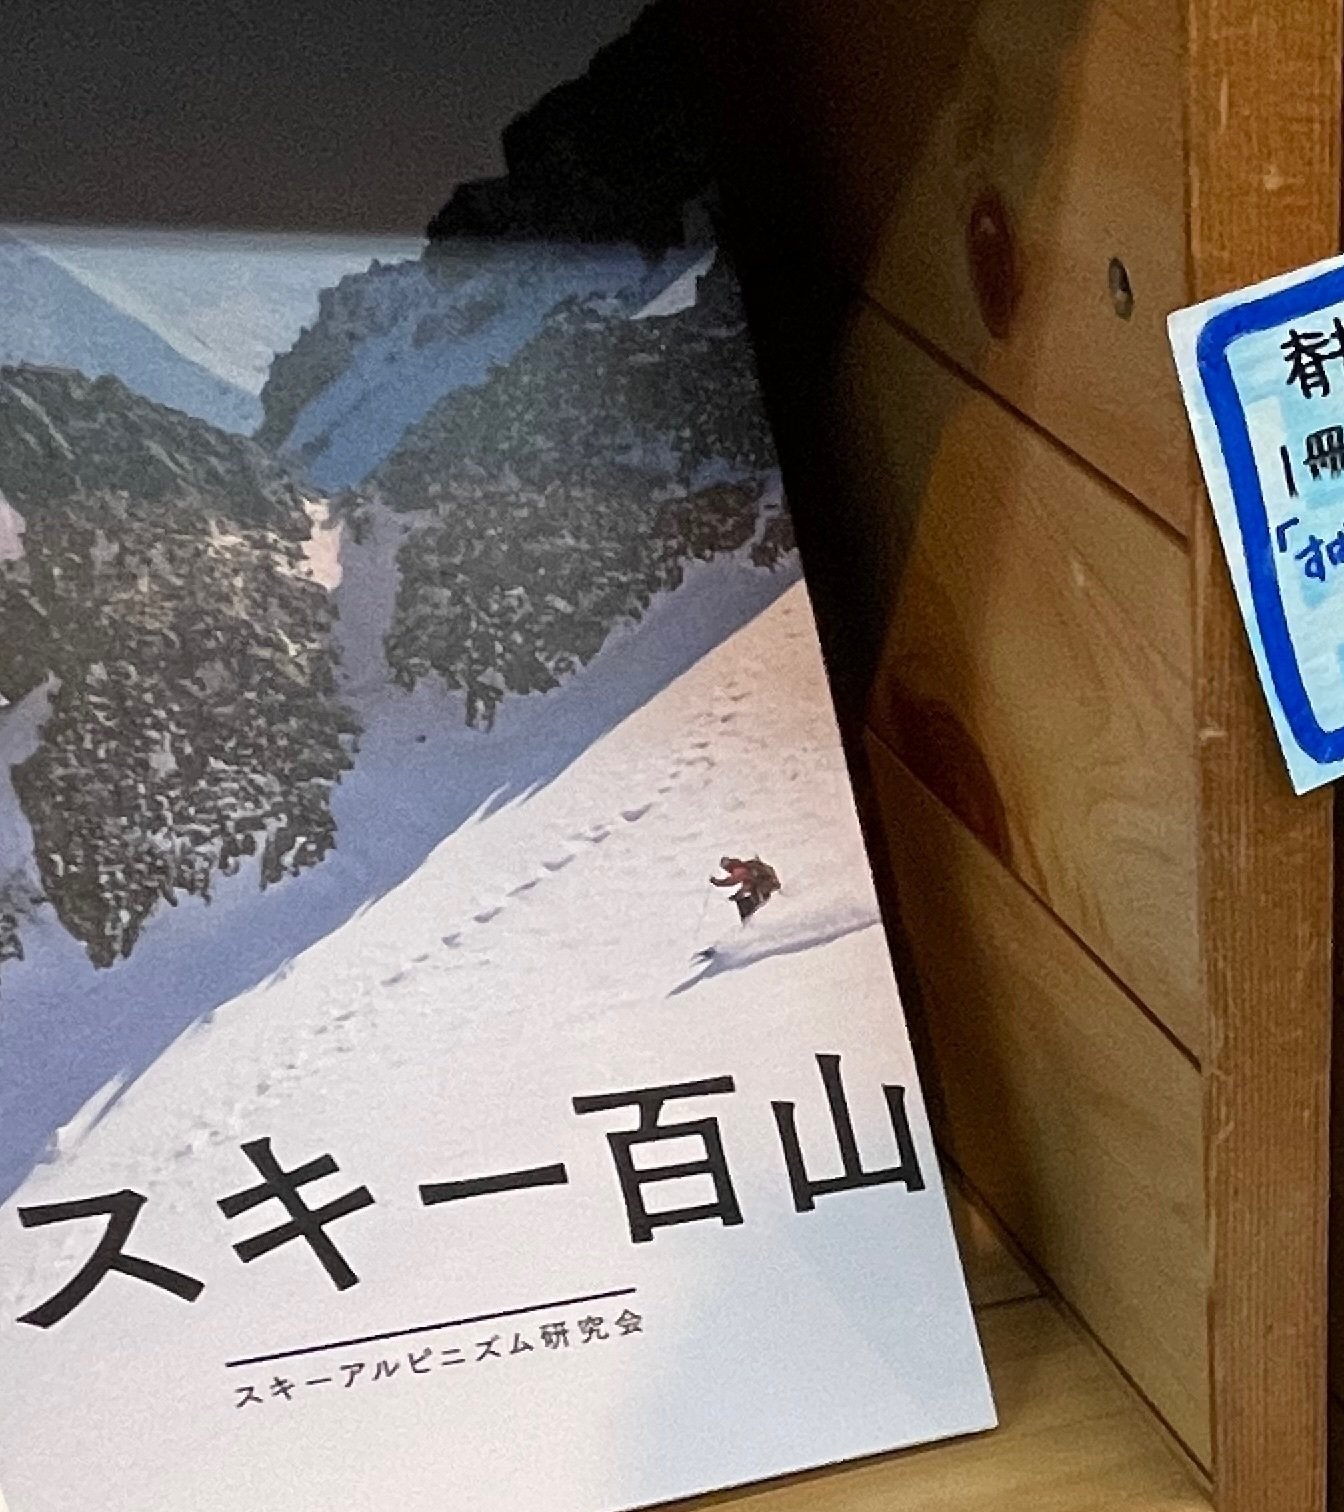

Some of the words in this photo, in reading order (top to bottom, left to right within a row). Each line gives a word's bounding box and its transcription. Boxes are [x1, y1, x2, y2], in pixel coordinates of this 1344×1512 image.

[16, 1053, 926, 1328] スキー百山
[234, 1307, 645, 1410] スキーアルピニズム研究会
